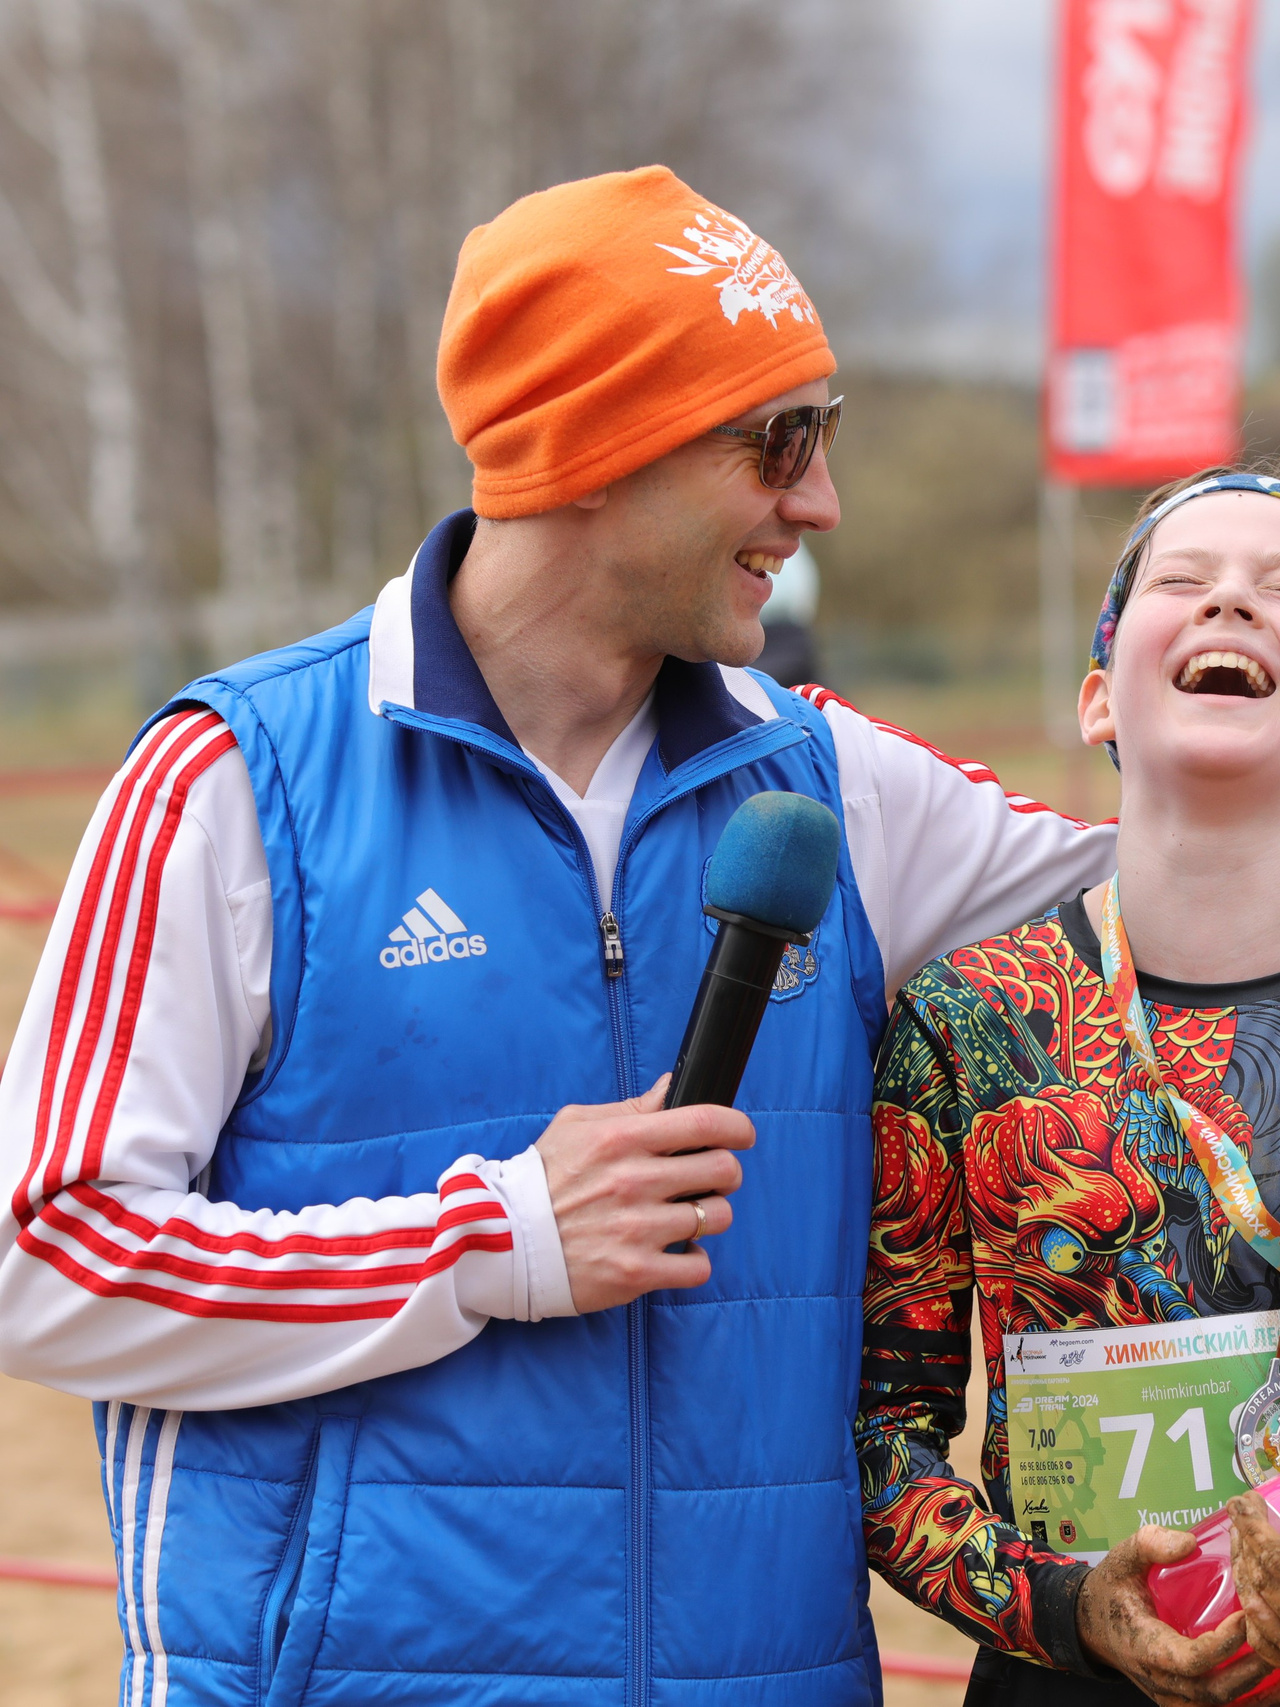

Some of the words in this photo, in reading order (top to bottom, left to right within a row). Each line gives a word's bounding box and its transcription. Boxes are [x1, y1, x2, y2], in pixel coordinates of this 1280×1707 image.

[378, 932, 488, 969] adidas
[1199, 1126, 1271, 1238] #ХИМКИНСКИЙ
[1058, 1338, 1094, 1347] begoem.com
[1103, 1324, 1248, 1366] ХИМКИНСКИЙ
[1254, 1326, 1280, 1348] ЛЕ
[1035, 1395, 1070, 1404] DREAM
[1071, 1394, 1099, 1408] 2024
[1141, 1378, 1231, 1402] #khimkirunbar
[1039, 1403, 1067, 1411] TRAIL
[1028, 1428, 1056, 1451] 7,00
[1099, 1406, 1246, 1499] 71
